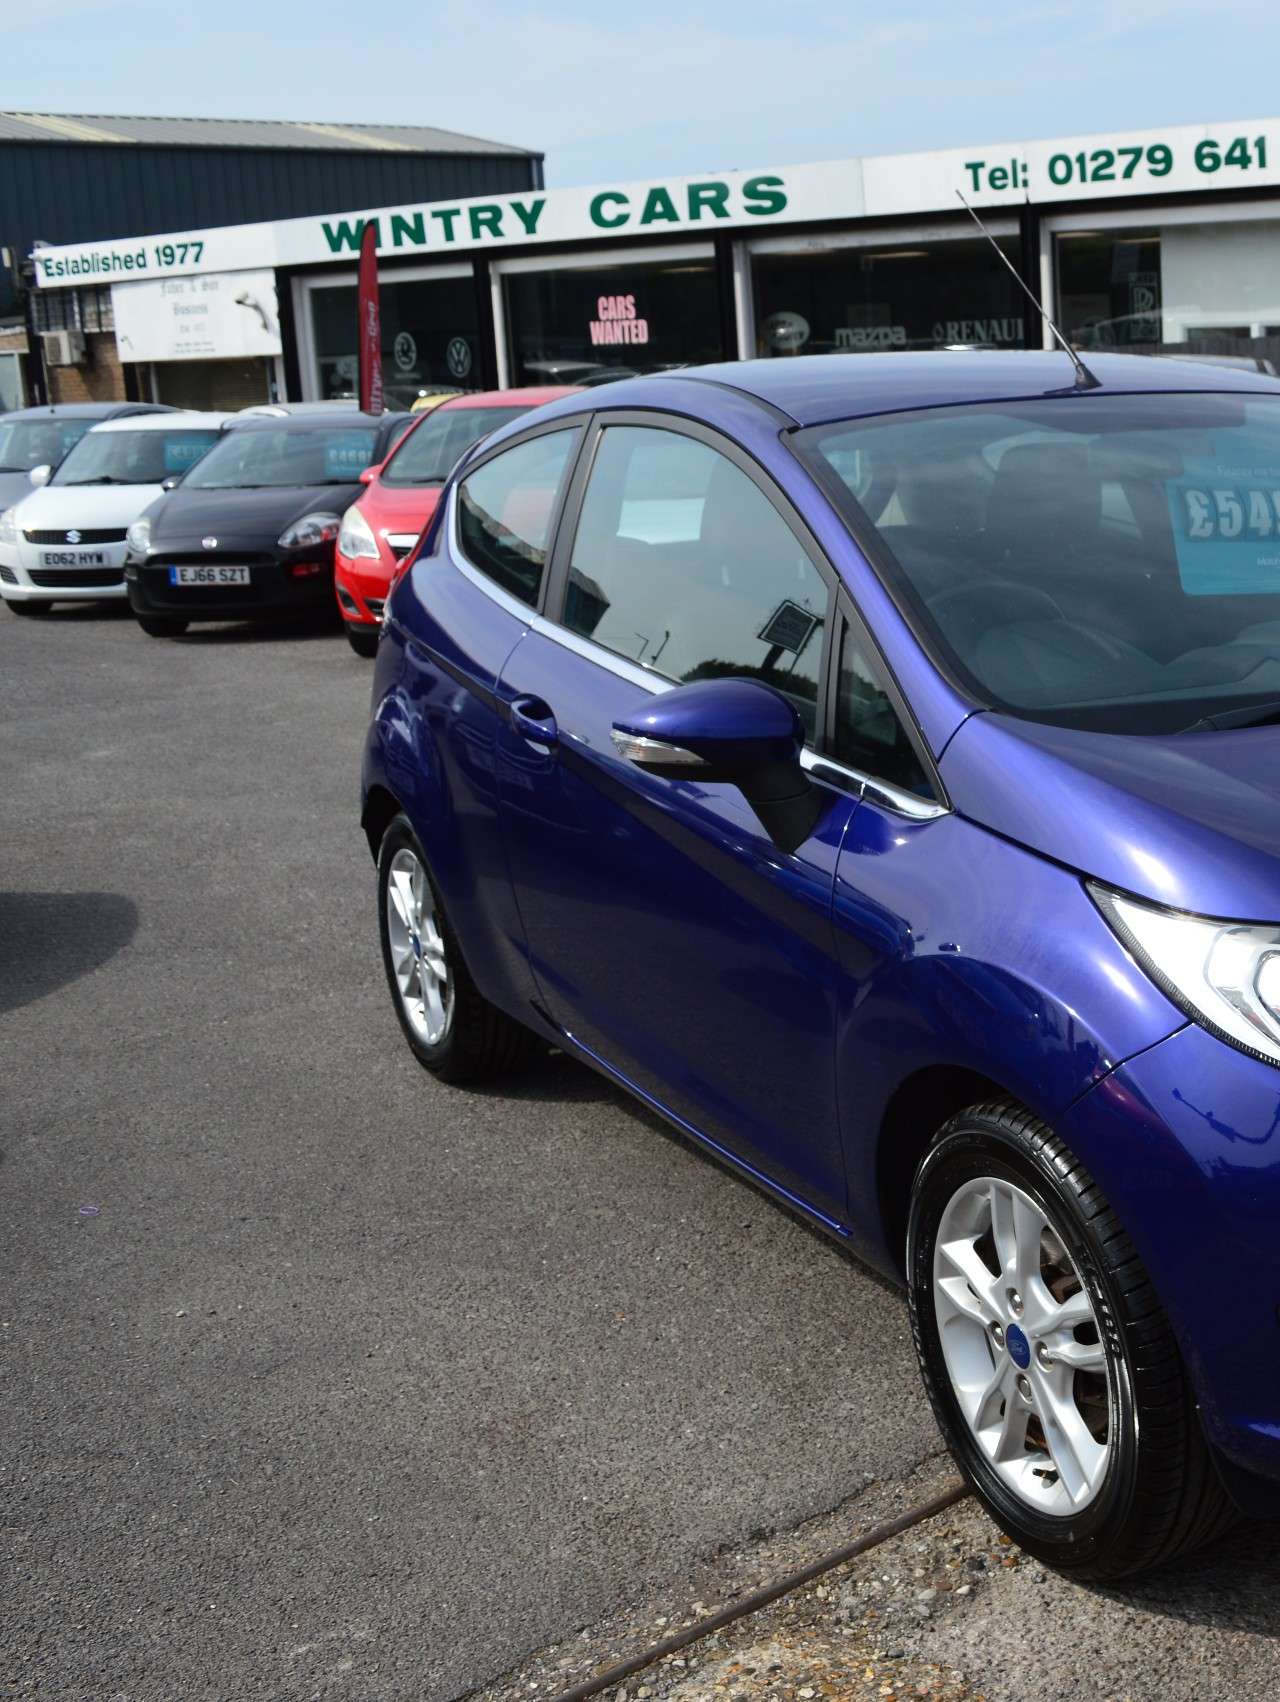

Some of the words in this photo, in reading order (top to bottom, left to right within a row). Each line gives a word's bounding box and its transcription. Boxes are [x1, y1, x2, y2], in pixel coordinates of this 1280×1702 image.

[965, 158, 1028, 191] Tel:
[1048, 144, 1173, 185] 01279
[1194, 136, 1266, 173] 641
[321, 199, 546, 253] WINTRY
[590, 176, 788, 228] CARS
[43, 248, 147, 277] Established
[156, 241, 204, 267] 1977
[598, 294, 636, 320] CARS
[590, 319, 648, 345] WANTED
[180, 568, 215, 582] EJ66
[219, 568, 246, 582] SZT
